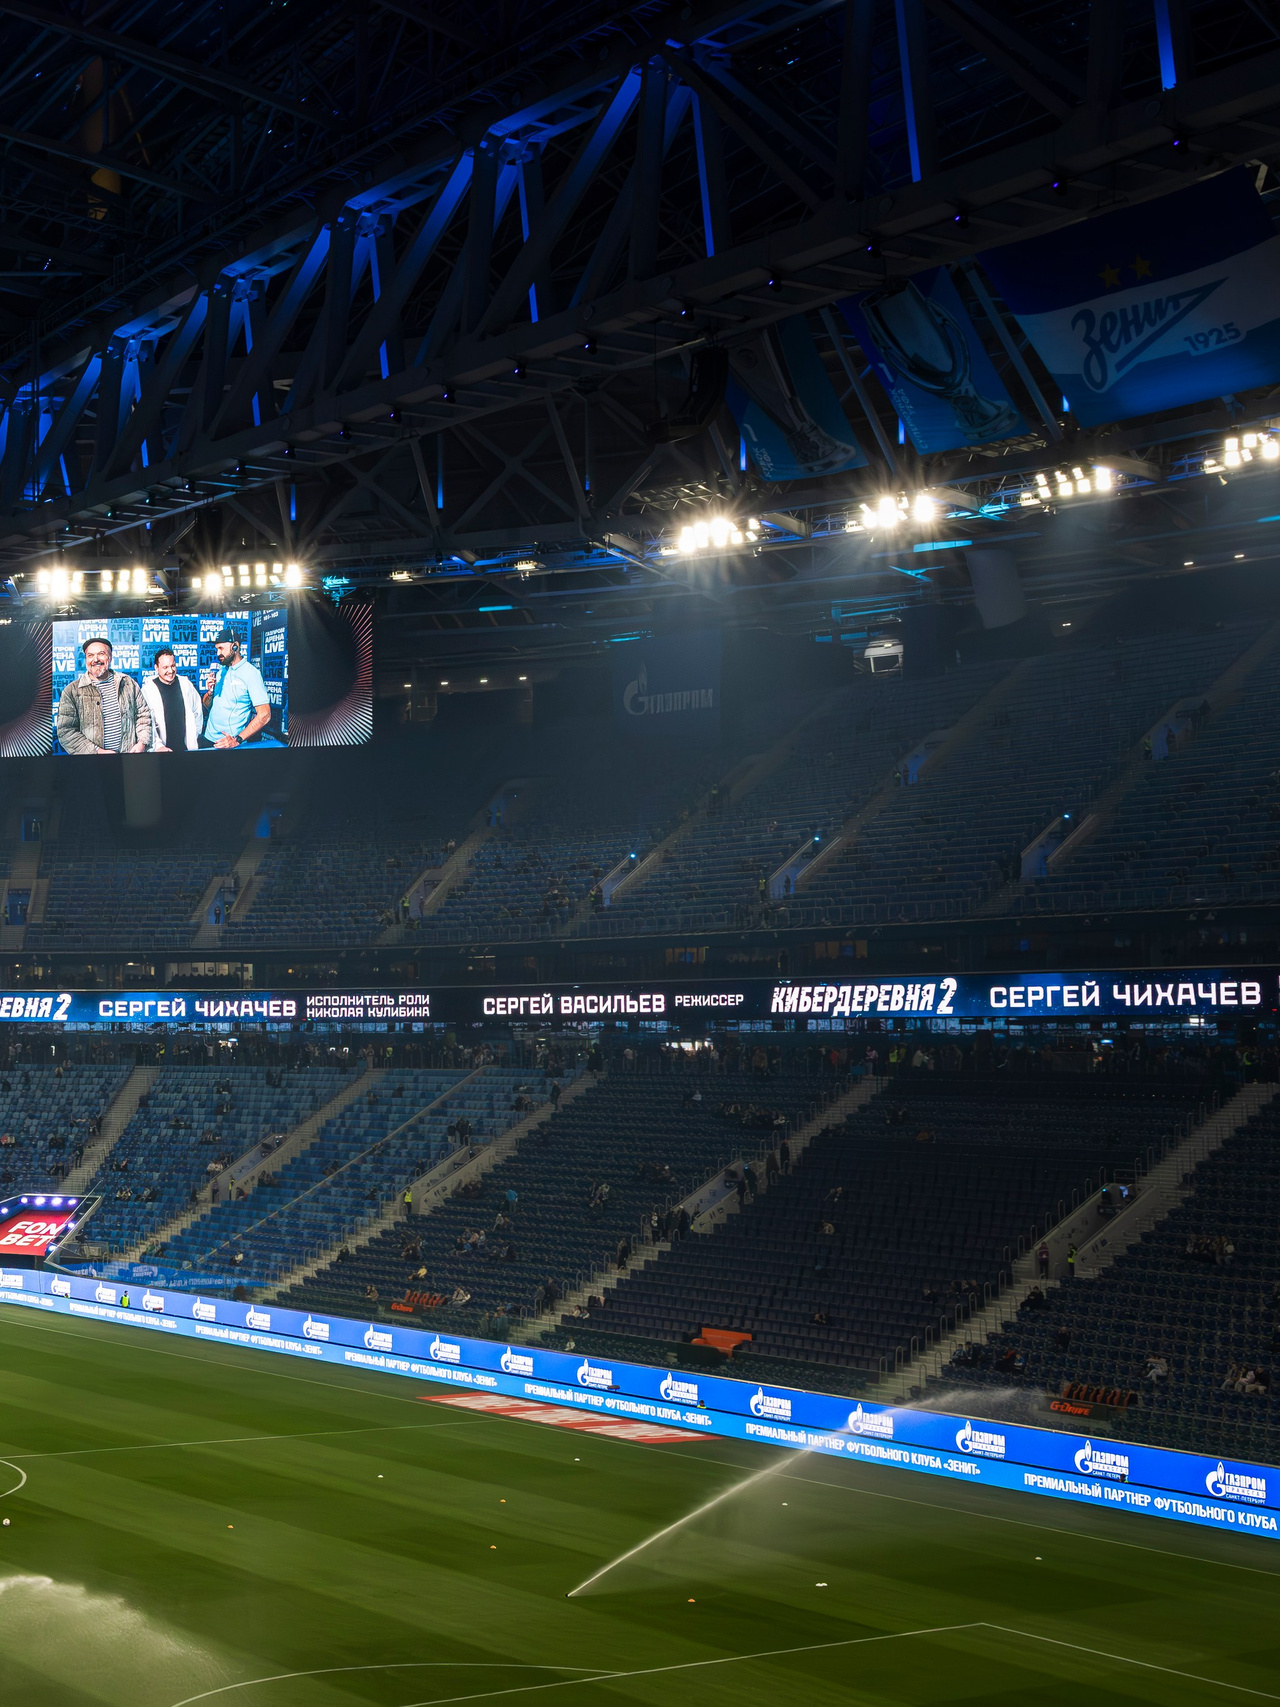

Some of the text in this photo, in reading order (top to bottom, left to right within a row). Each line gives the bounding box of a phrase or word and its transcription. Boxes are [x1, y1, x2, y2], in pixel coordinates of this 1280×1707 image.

[1184, 321, 1241, 352] 1925
[111, 632, 139, 642] LIVE
[142, 632, 170, 642] LIVE
[172, 632, 197, 642] LIVE
[265, 635, 284, 643] АРЕНА
[265, 643, 284, 654] LIVE
[111, 658, 139, 669] LIVE
[648, 688, 714, 714] ГАЗПРОМ
[307, 995, 429, 1006] ИСПОЛНИТЕЛЬ РОЛИ
[675, 994, 743, 1006] РЕЖИССЕР
[771, 978, 957, 1017] КИБЕРДЕРЕВНЯ 2
[990, 981, 1260, 1007] СЕРГЕЙ ЧИХАЧЕВ
[52, 993, 72, 1020] 2
[99, 998, 296, 1016] СЕРГЕЙ ЧИХАЧЕВ
[484, 993, 664, 1014] СЕРГЕЙ ВАСИЛЬЕВ
[307, 1007, 429, 1017] НИКОЛАЯ КУЛИБИНА
[8, 1220, 65, 1236] FON
[345, 1351, 497, 1386] ПРЕМИАЛЬНЫЙ ПАРТНЕР ФУТБОЛЬНОГО КЛУБА «ЗЕНИТ»
[589, 1367, 612, 1380] ГАЗПРОМ
[672, 1381, 697, 1395] ГАЗПРОМ
[524, 1383, 573, 1403] ПРЕМИАЛЬНЫЙ
[574, 1392, 604, 1406] ПАРТНЕР
[605, 1398, 656, 1416] ФУТБОЛЬНОГО
[657, 1407, 681, 1421] КЛУБА
[683, 1412, 712, 1425] «ЗЕНИТ»
[763, 1396, 791, 1410] ГАЗПРОМ
[1049, 1400, 1091, 1416] G-DRIVE
[862, 1413, 893, 1428] ГАЗПРОМ
[972, 1431, 1005, 1448] ГАЗПРОМ
[746, 1423, 980, 1475] ПРЕМИАЛЬНЫЙ ПАРТНЕР ФУТБОЛЬНОГО КЛУБА «ЗЕНИТ»
[1092, 1451, 1128, 1468] ГАЗПРОМ
[1225, 1474, 1265, 1492] ГАЗПРОМ
[1024, 1472, 1102, 1498] ПРЕМИАЛЬНЫЙ
[1104, 1488, 1151, 1506] ПАРТНЕР
[1154, 1497, 1235, 1522] ФУТБОЛЬНОГО
[1238, 1512, 1277, 1531] КЛУБА
[1225, 1493, 1266, 1503] САНКТ-ПЕТЕРБУРГ
